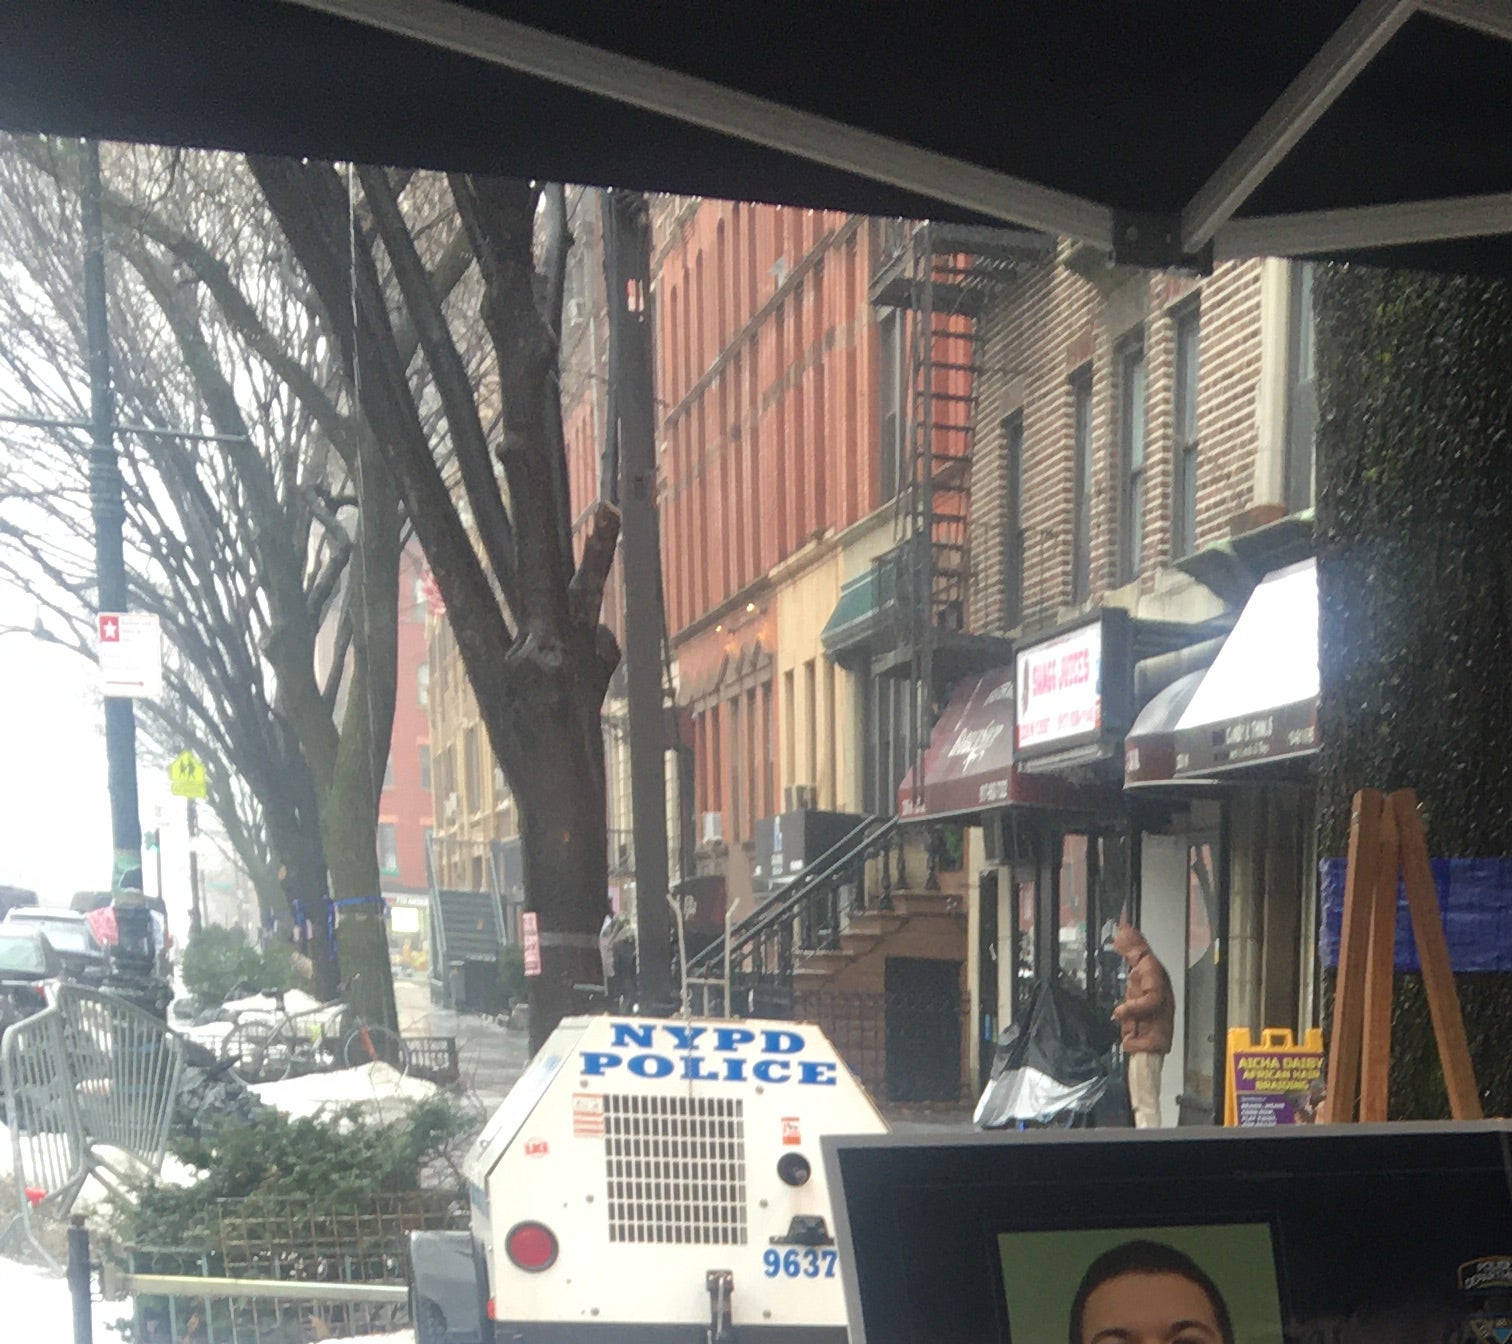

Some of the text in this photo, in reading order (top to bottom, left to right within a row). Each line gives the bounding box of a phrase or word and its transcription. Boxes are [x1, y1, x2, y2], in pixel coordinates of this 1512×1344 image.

[610, 1023, 804, 1054] NYPD
[580, 1052, 837, 1086] POLICE
[1243, 1070, 1291, 1080] AFRICAN
[1256, 1080, 1309, 1091] BRAIDING
[763, 1249, 838, 1278] 9637
